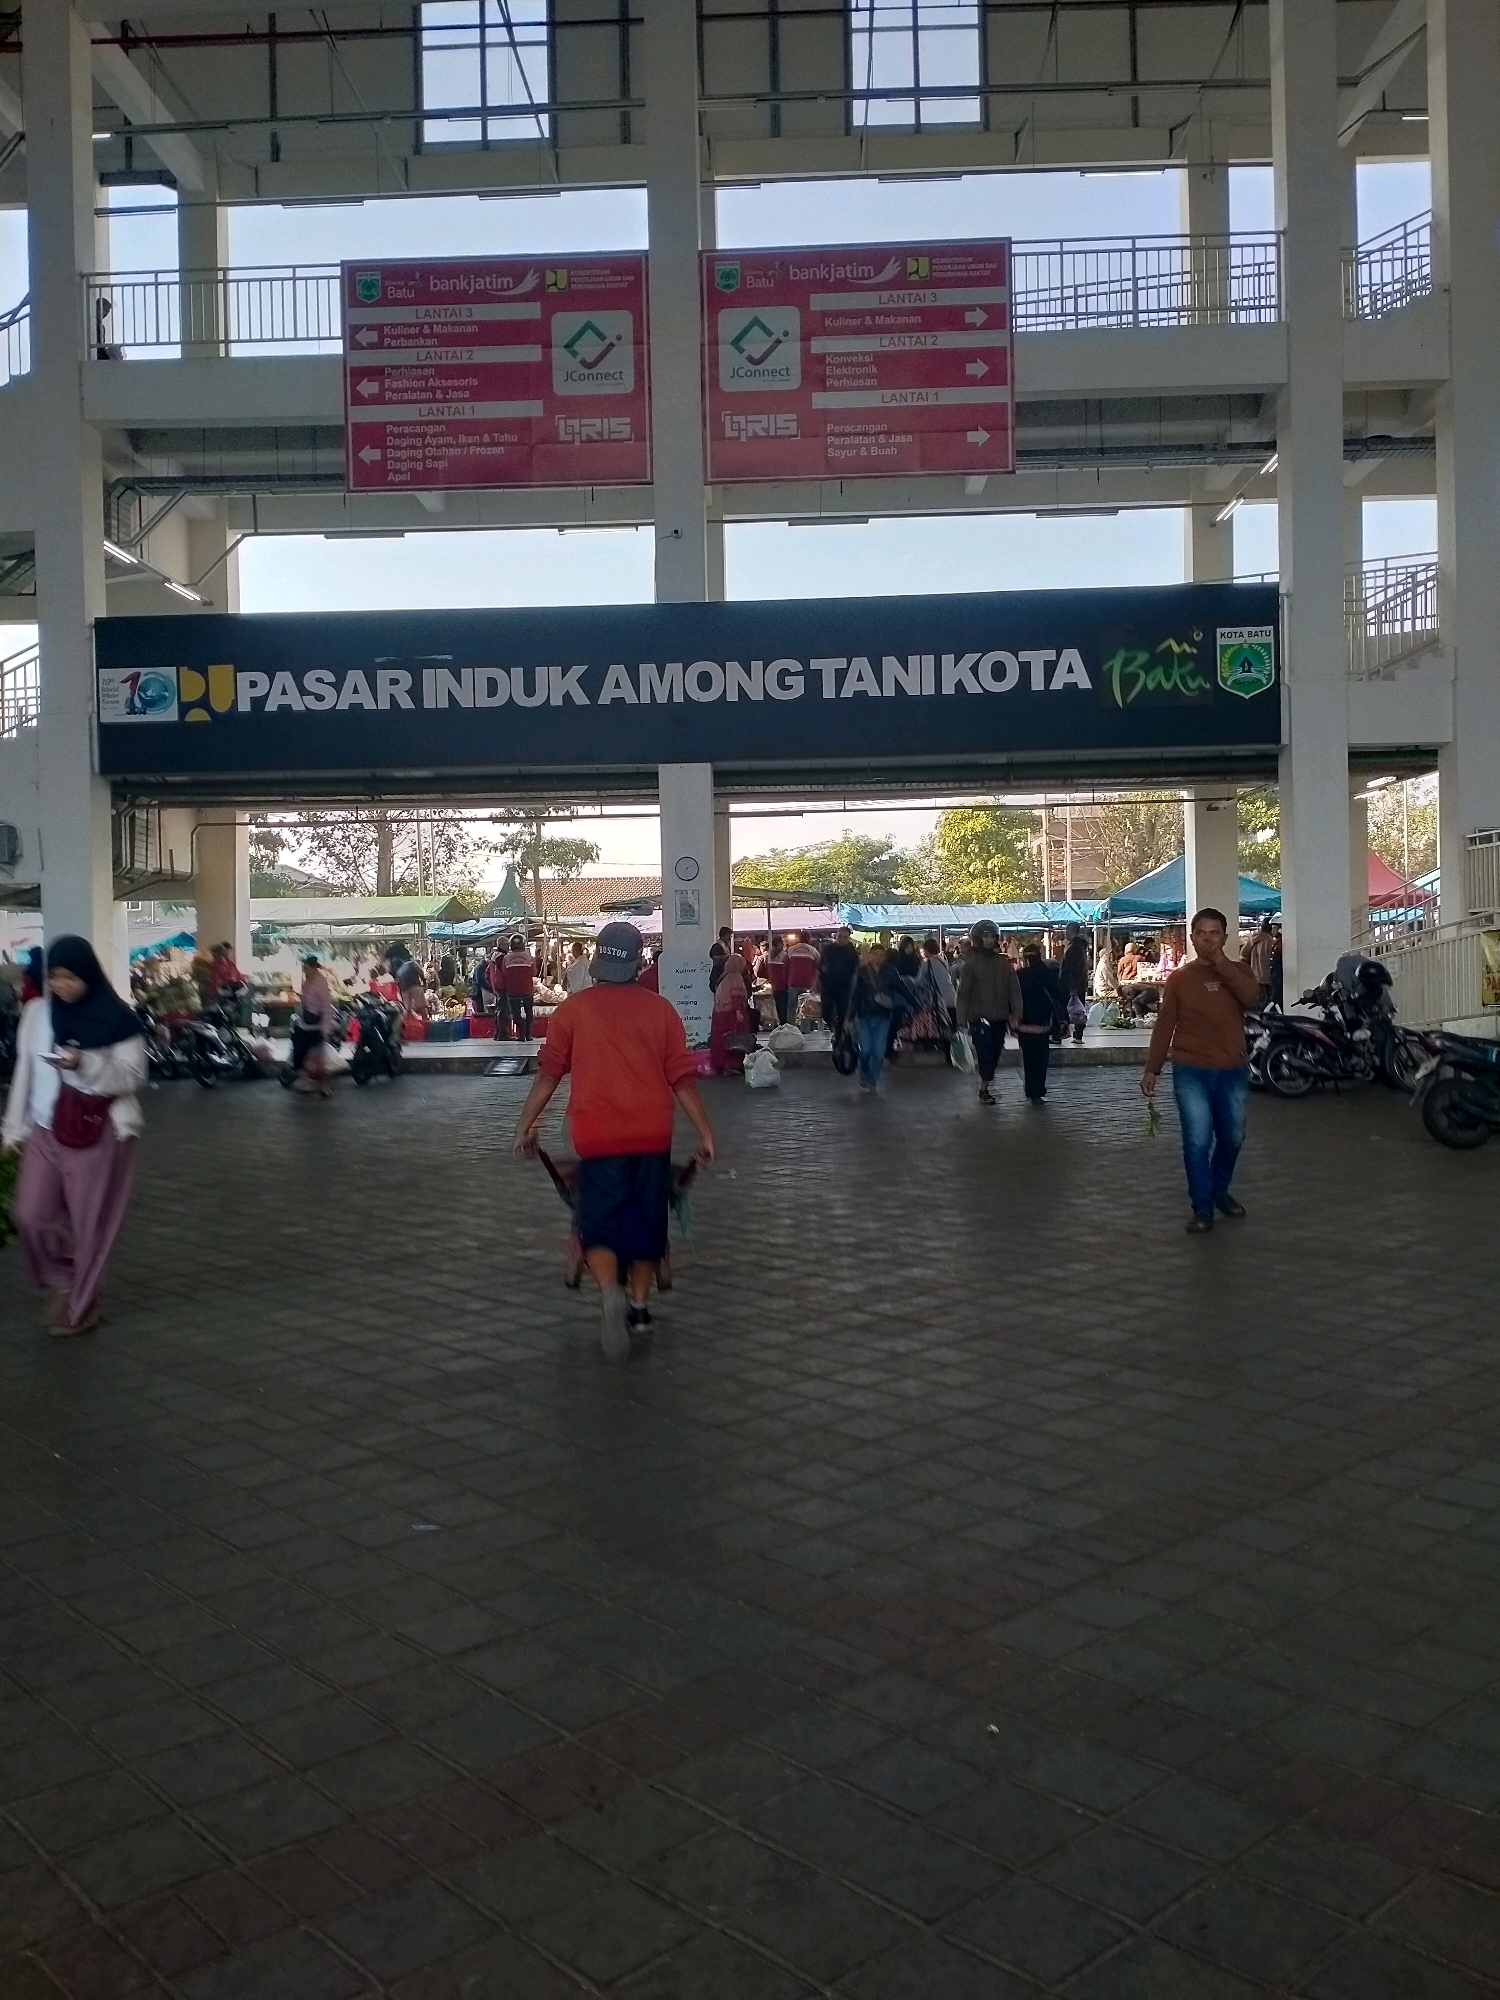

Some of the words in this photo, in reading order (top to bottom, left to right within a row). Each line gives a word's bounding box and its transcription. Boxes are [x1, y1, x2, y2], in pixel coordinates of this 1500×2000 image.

[789, 262, 874, 282] bankjatim
[429, 274, 514, 294] bankjatim
[746, 275, 775, 288] Batu
[387, 286, 415, 298] Batu
[878, 292, 926, 304] LANTAI
[930, 292, 938, 302] 3
[415, 307, 462, 319] LANTAI
[466, 307, 473, 318] 3
[824, 317, 861, 327] Kuliner
[864, 315, 872, 325] &
[875, 314, 922, 325] Makanan
[383, 324, 420, 335] Kuliner
[422, 324, 431, 334] &
[433, 323, 479, 334] Makanan
[384, 337, 438, 347] Perbankan
[880, 335, 927, 347] LANTAI
[931, 335, 938, 346] 2
[416, 350, 463, 361] LANTAI
[466, 349, 474, 360] 2
[825, 353, 874, 364] Konveksi
[384, 367, 435, 376] Perhiasan
[730, 366, 790, 378] JConnect
[826, 364, 878, 375] Elektronik
[563, 370, 624, 382] JConnect
[826, 377, 877, 387] Perhiasan
[384, 378, 426, 388] Fashion
[427, 377, 479, 387] Aksesoris
[385, 390, 433, 400] Peralatan
[435, 389, 443, 399] &
[445, 389, 470, 398] Jasa
[881, 391, 929, 403] LANTAI
[933, 391, 939, 402] 1
[418, 405, 465, 417] LANTAI
[469, 405, 475, 415] 1
[386, 424, 446, 434] Peracangan
[827, 423, 888, 434] Peracangan
[386, 435, 422, 447] Daging
[425, 435, 456, 446] Ayam,
[458, 434, 480, 443] Ikan
[482, 433, 491, 443] &
[493, 432, 518, 442] Tahu
[827, 435, 875, 445] Peralatan
[878, 434, 886, 443] &
[888, 433, 913, 443] Jasa
[387, 448, 423, 459] Daging
[425, 446, 461, 456] Olahan
[469, 445, 505, 455] Frozen
[827, 447, 858, 459] Sayur
[860, 446, 868, 456] &
[870, 446, 898, 456] Buah
[387, 459, 423, 471] Daging
[425, 459, 448, 470] Sapi
[387, 471, 411, 482] Apel
[1219, 630, 1245, 640] KOTA
[1246, 629, 1272, 639] BATU
[236, 668, 416, 712] PASAR
[422, 665, 592, 709] INDUK
[597, 657, 805, 705] AMONG
[809, 654, 936, 699] TANI
[941, 648, 1093, 695] KOTA
